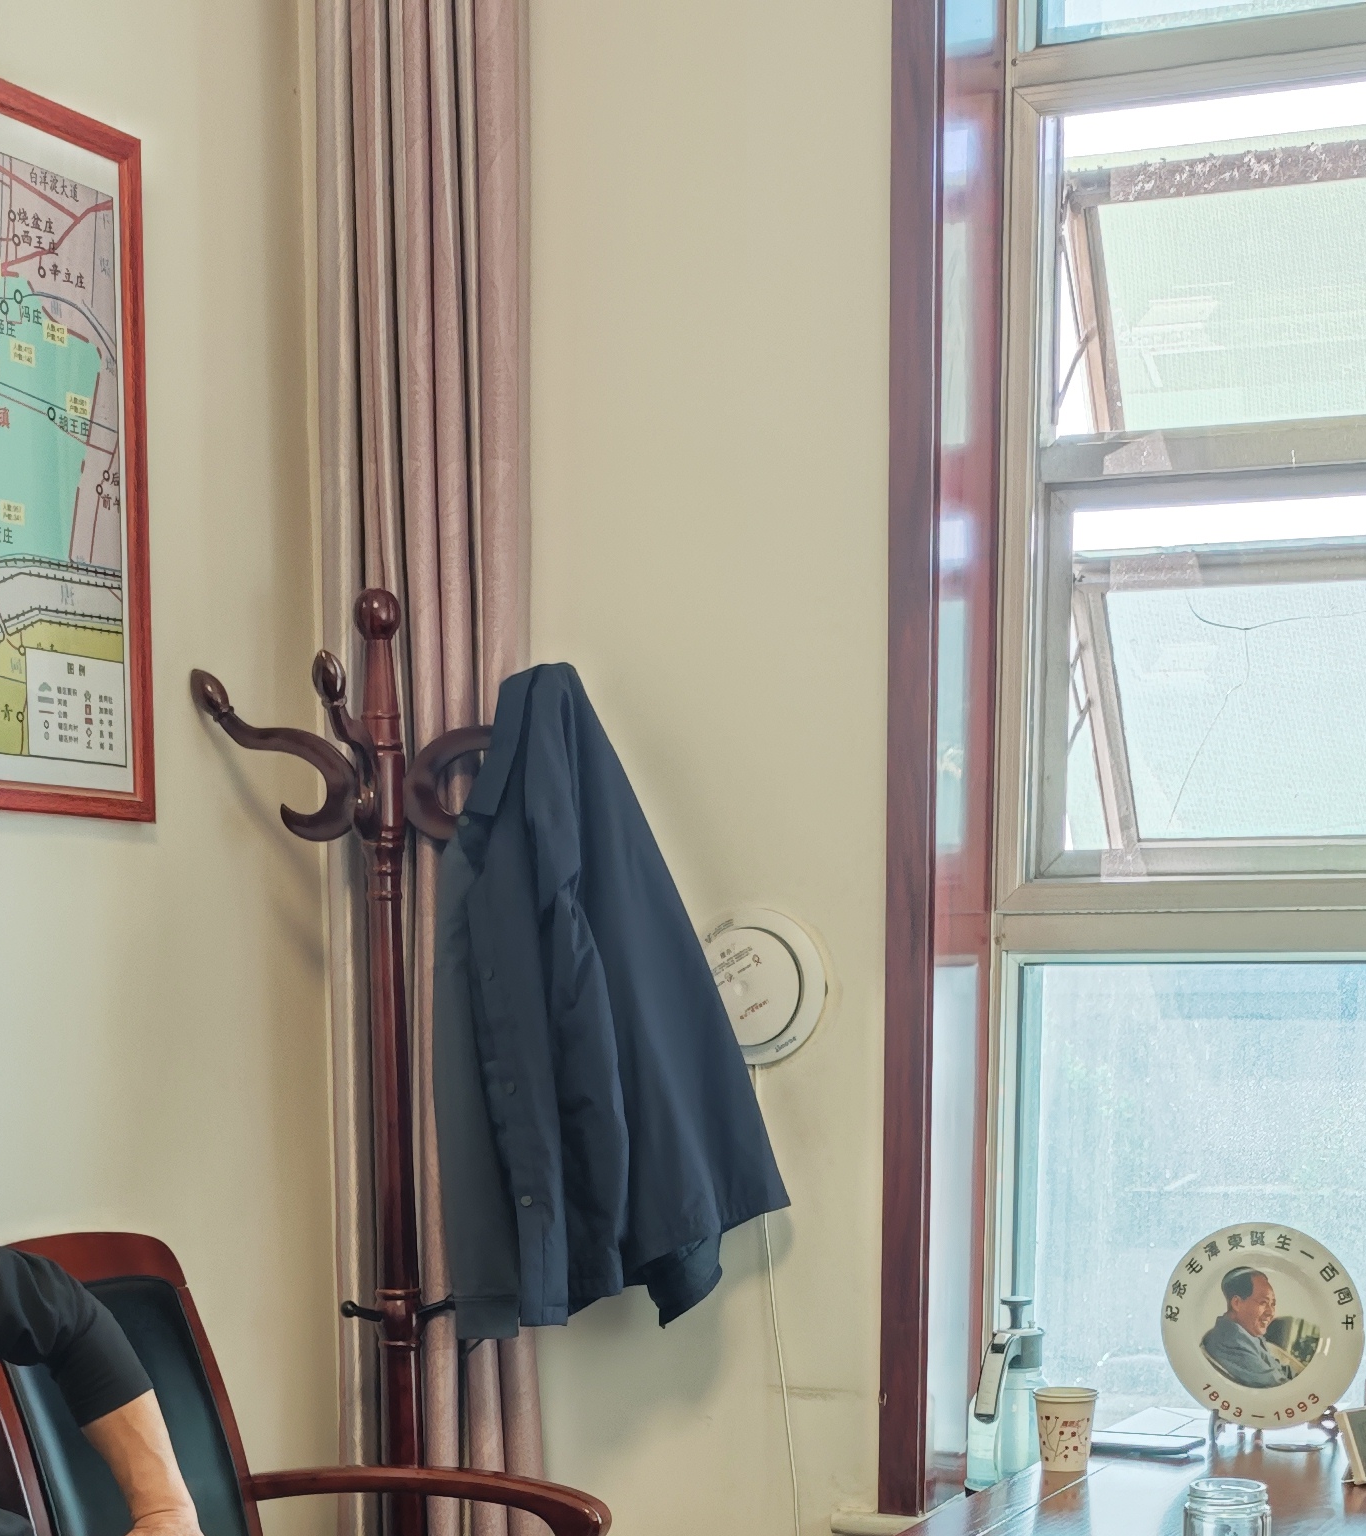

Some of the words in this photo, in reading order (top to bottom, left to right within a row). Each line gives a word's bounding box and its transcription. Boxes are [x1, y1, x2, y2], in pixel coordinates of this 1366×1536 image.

[29, 167, 80, 203] 白洋淀大道
[21, 230, 59, 256] 西王庄
[49, 263, 86, 290] 辛立庄
